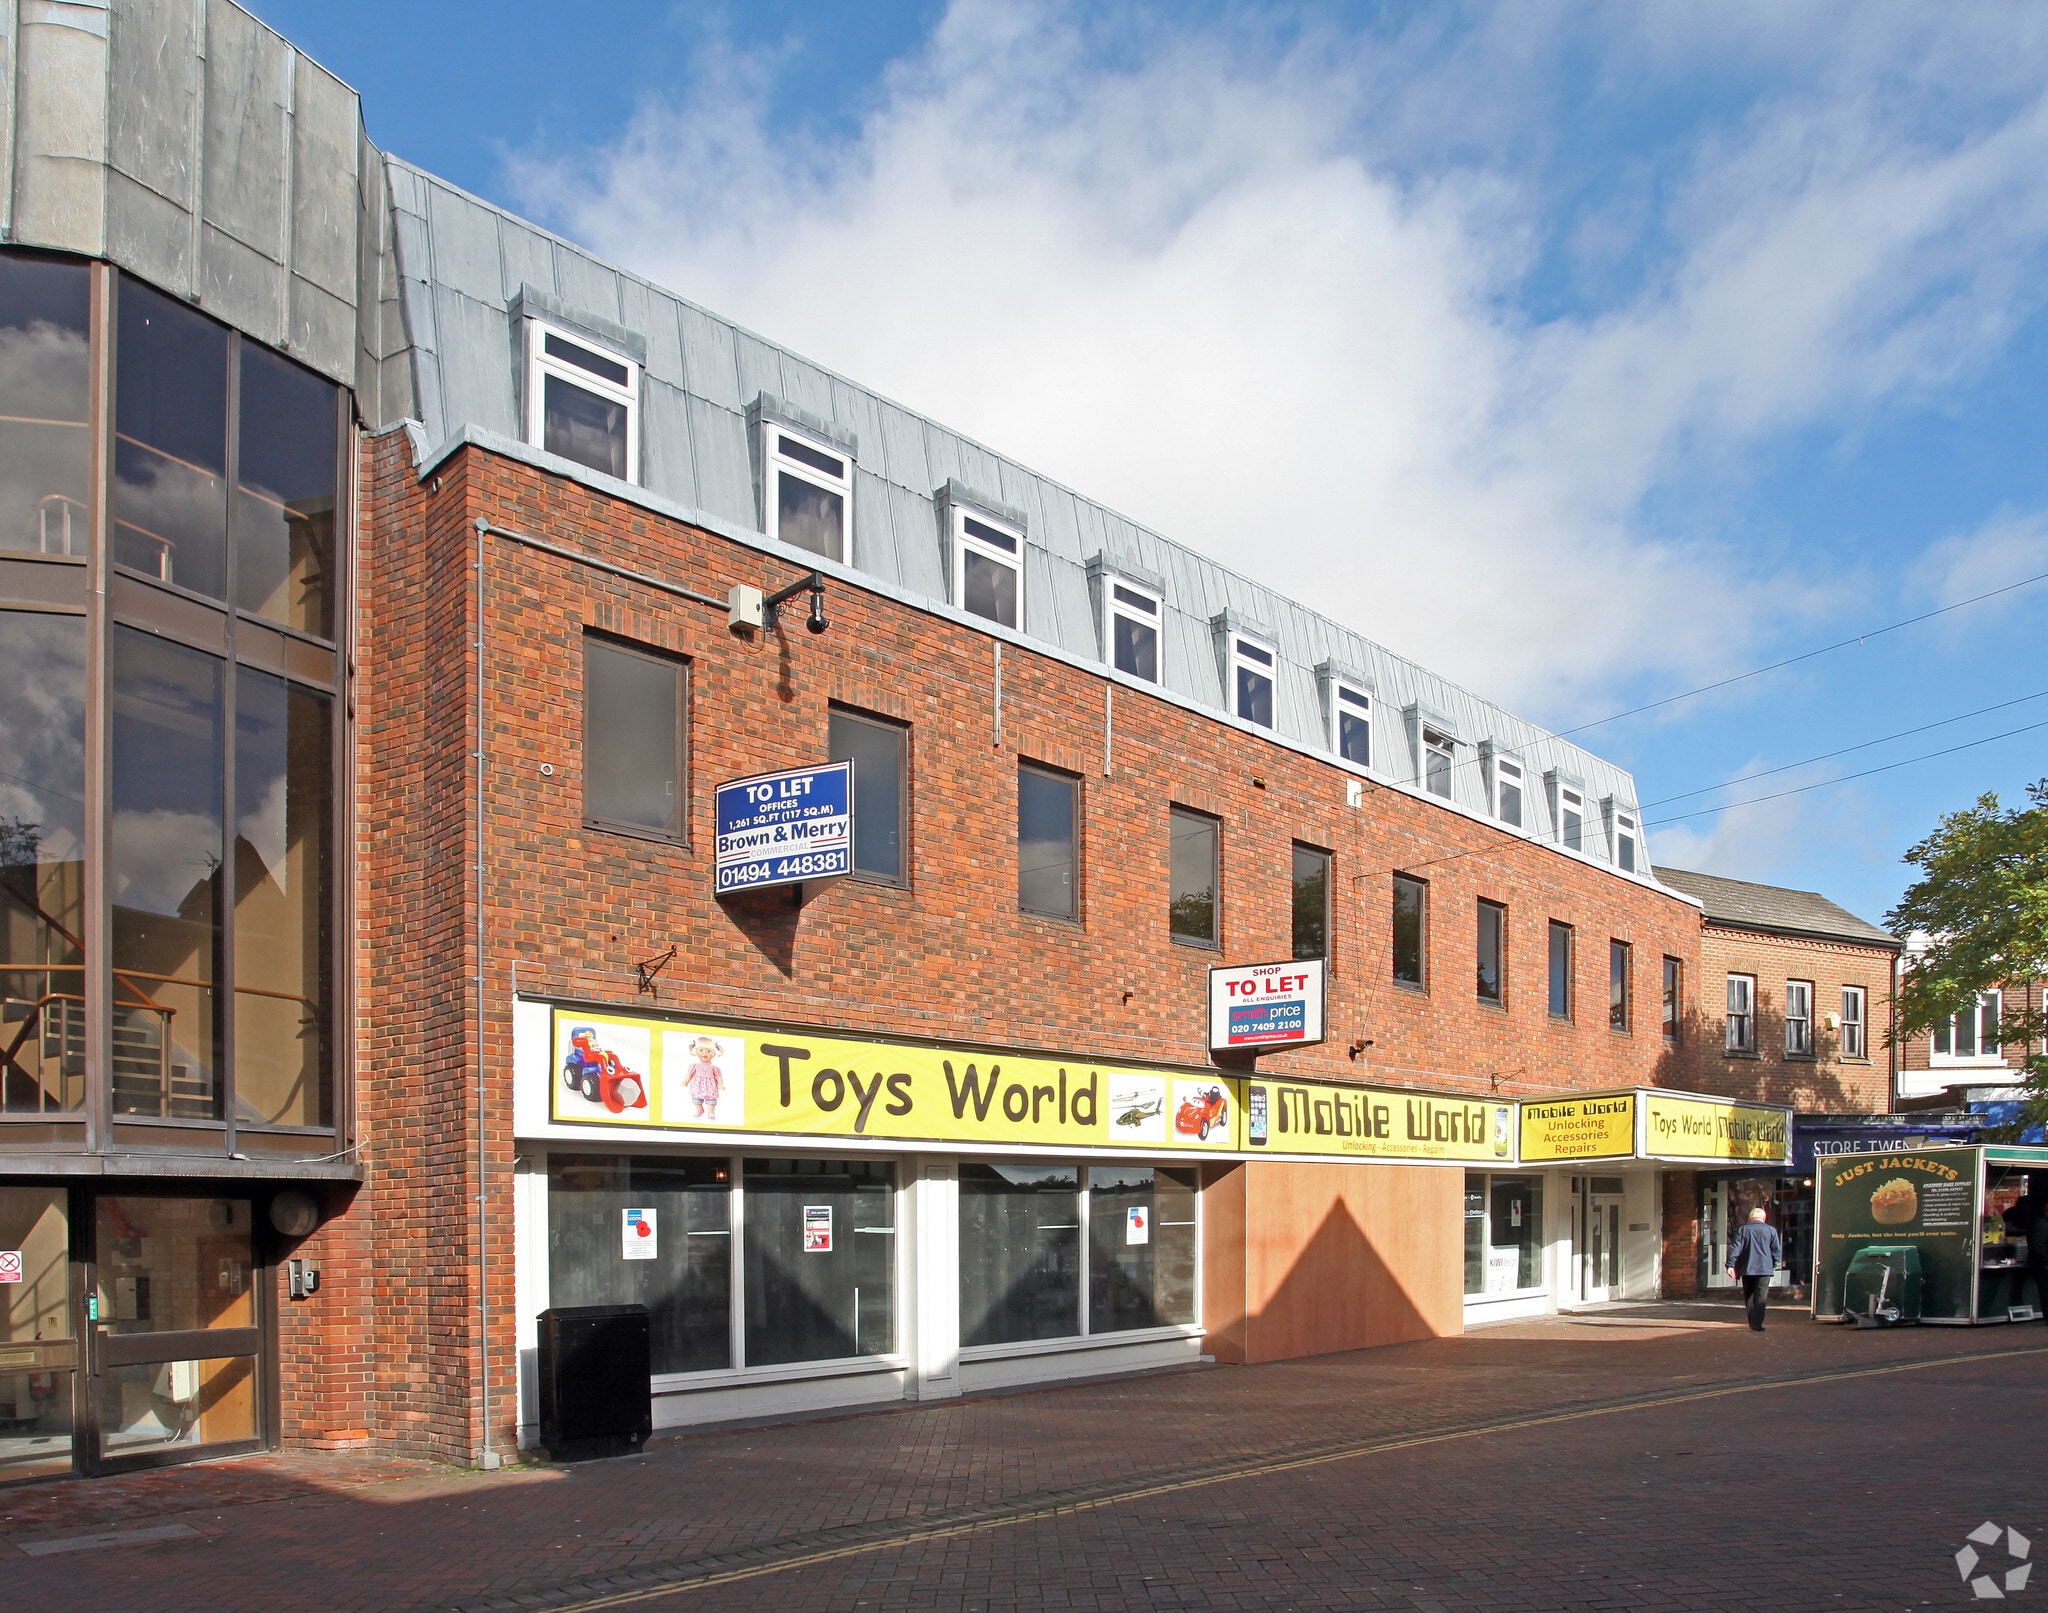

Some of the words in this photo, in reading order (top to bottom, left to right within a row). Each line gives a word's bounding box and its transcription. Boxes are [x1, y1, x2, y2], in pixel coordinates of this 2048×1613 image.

[747, 783, 773, 804] TO
[780, 776, 814, 798] LET
[759, 799, 798, 813] OFFICES
[729, 818, 750, 831] 1,261
[753, 812, 779, 825] SQ.FT
[781, 809, 801, 822] (117
[803, 804, 834, 816] SQ.M)
[719, 832, 770, 853] Brown
[773, 826, 788, 842] &
[791, 820, 848, 840] Merry
[750, 842, 810, 858] COMMERCIAL
[721, 861, 771, 886] 01494
[777, 851, 845, 876] 448381
[1252, 967, 1281, 976] SHOP
[1225, 980, 1256, 997] TO
[1265, 974, 1309, 993] LET
[1256, 994, 1292, 1002] ENQUIRIES
[1270, 1004, 1301, 1021] price
[1231, 1024, 1250, 1033] 020
[1252, 1022, 1275, 1032] 7409
[1277, 1020, 1302, 1029] 2100
[760, 1043, 913, 1133] Toys
[943, 1059, 1097, 1126] World
[1278, 1086, 1389, 1138] Mobile
[1407, 1099, 1486, 1144] World
[1528, 1106, 1576, 1119] Mobile
[1583, 1101, 1627, 1115] World
[1548, 1119, 1605, 1131] Unlocking
[1652, 1111, 1677, 1140] Toys
[1681, 1114, 1712, 1136] World
[1718, 1116, 1752, 1141] Mobile
[1543, 1130, 1609, 1143] Accessories
[1342, 1140, 1377, 1153] Unlocking
[1382, 1142, 1418, 1153] Accessories
[1423, 1144, 1445, 1155] Repairs
[1555, 1143, 1597, 1155] Repairs
[1813, 1140, 1861, 1156] STORE
[1835, 1161, 1875, 1187] JUST
[1879, 1157, 1959, 1181] JACKETS
